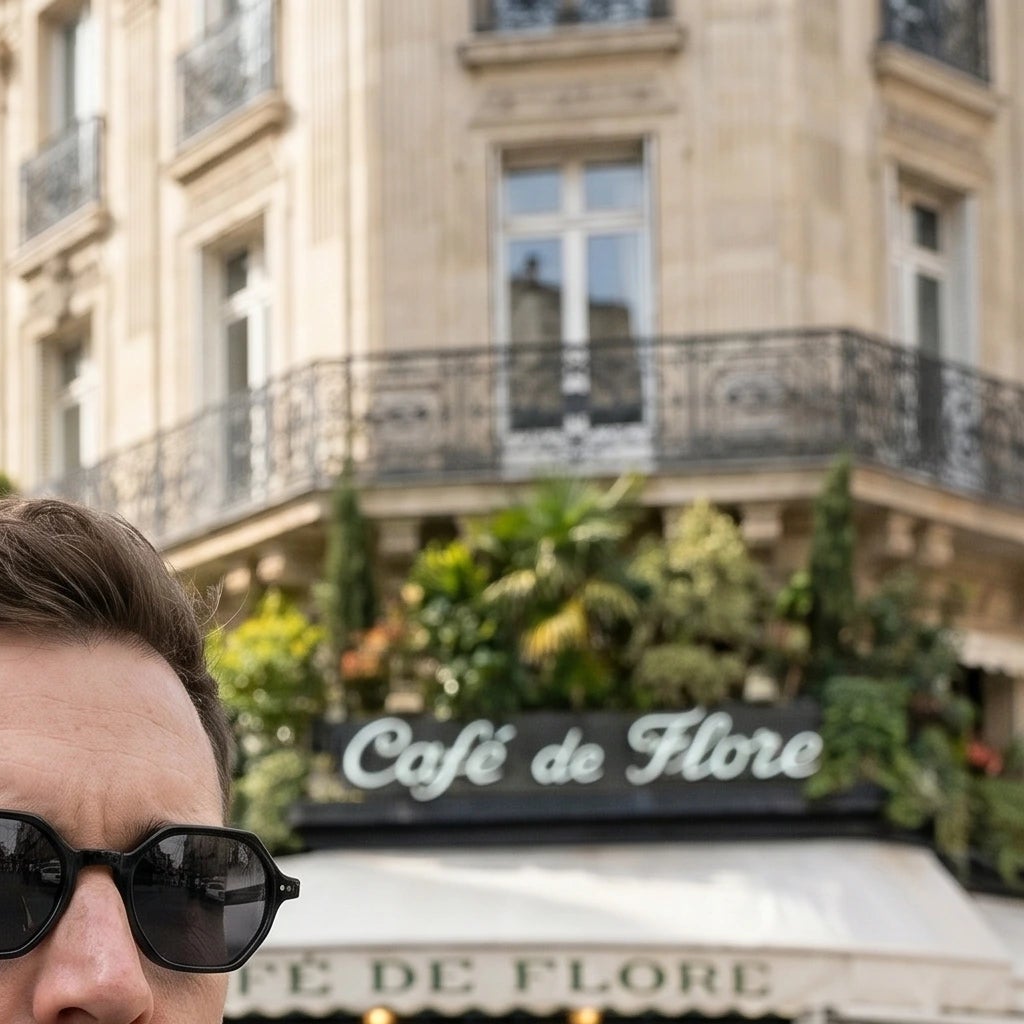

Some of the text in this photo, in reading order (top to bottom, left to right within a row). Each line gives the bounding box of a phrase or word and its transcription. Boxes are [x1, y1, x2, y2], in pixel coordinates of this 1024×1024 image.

[342, 706, 824, 801] Café de Flore
[238, 951, 772, 997] FÉ DE FLORE
